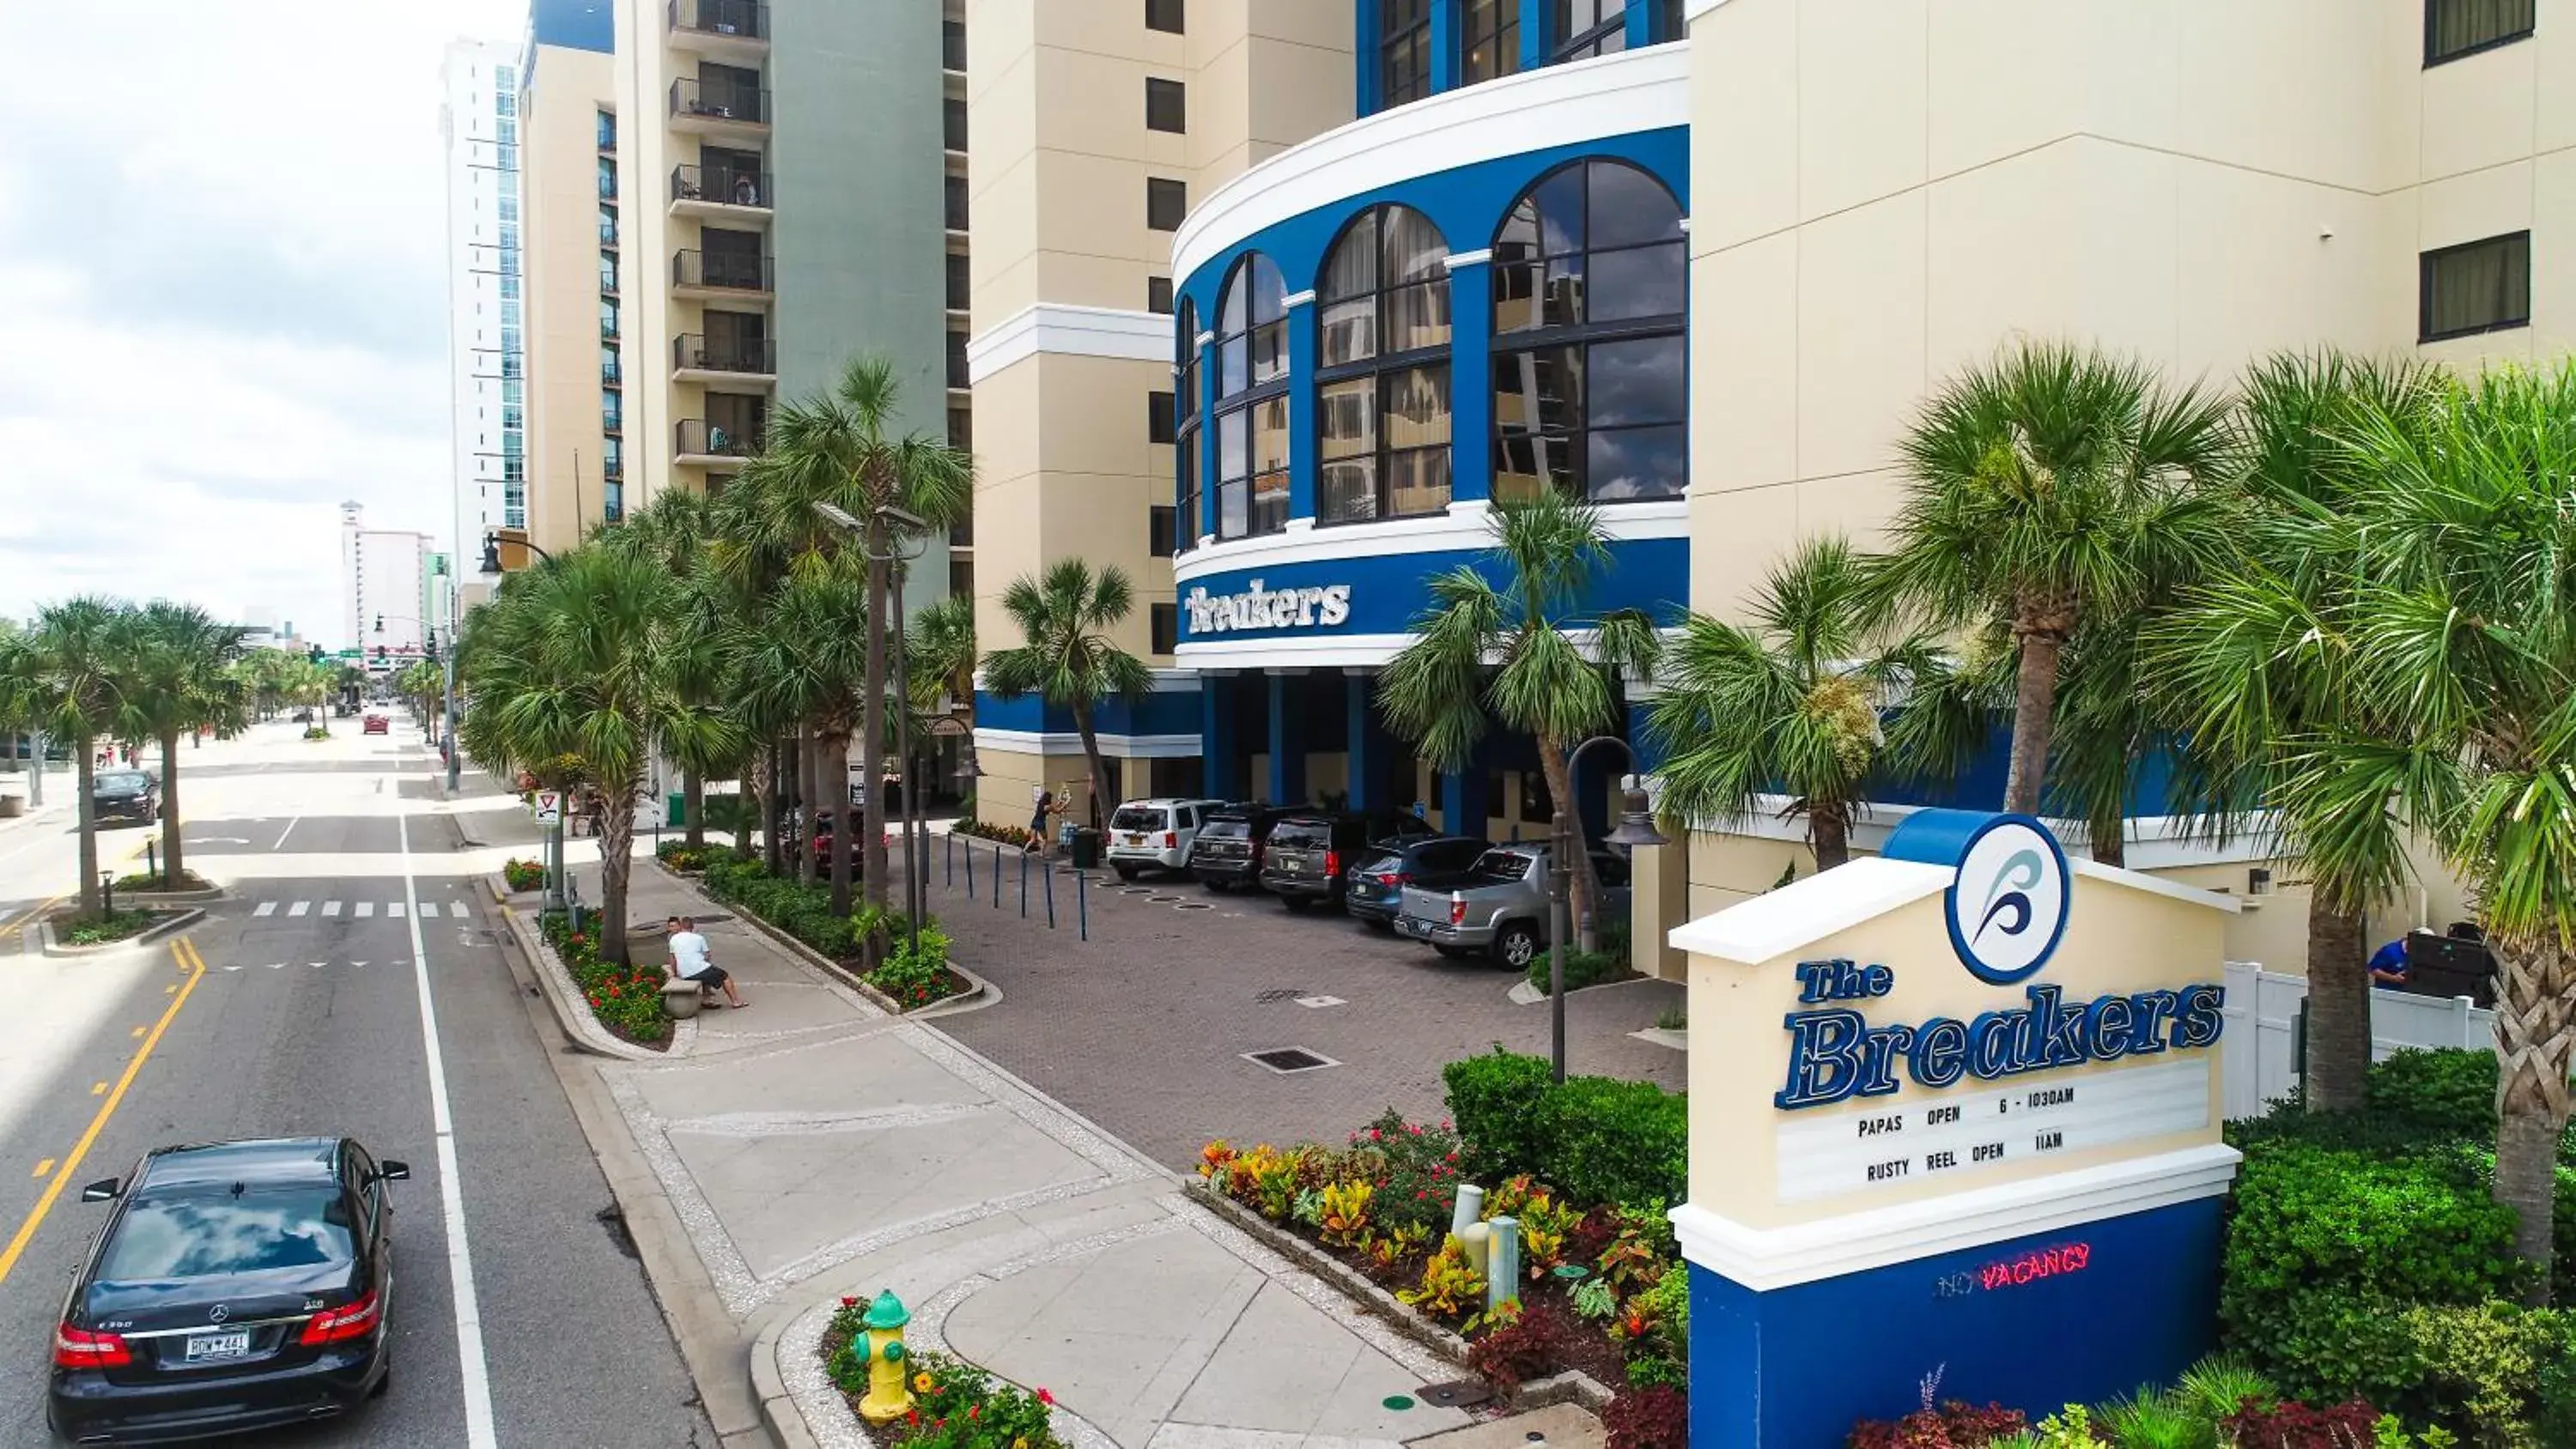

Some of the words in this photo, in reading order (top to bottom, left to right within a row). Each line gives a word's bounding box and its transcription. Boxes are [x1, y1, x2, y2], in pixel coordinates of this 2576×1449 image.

[1795, 959, 1893, 1003] The
[1774, 984, 2226, 1111] Breakers
[1858, 1115, 1903, 1138] PAPAS
[1927, 1105, 1961, 1125] OPEN
[1999, 1099, 2008, 1114] 6
[2028, 1088, 2075, 1108] 1030AM
[1867, 1159, 1910, 1182] RUSTY
[1926, 1151, 1958, 1171] REEL
[1972, 1143, 2004, 1162] OPEN
[2035, 1132, 2063, 1151] 11AM
[1982, 1242, 2090, 1291] VACANCY
